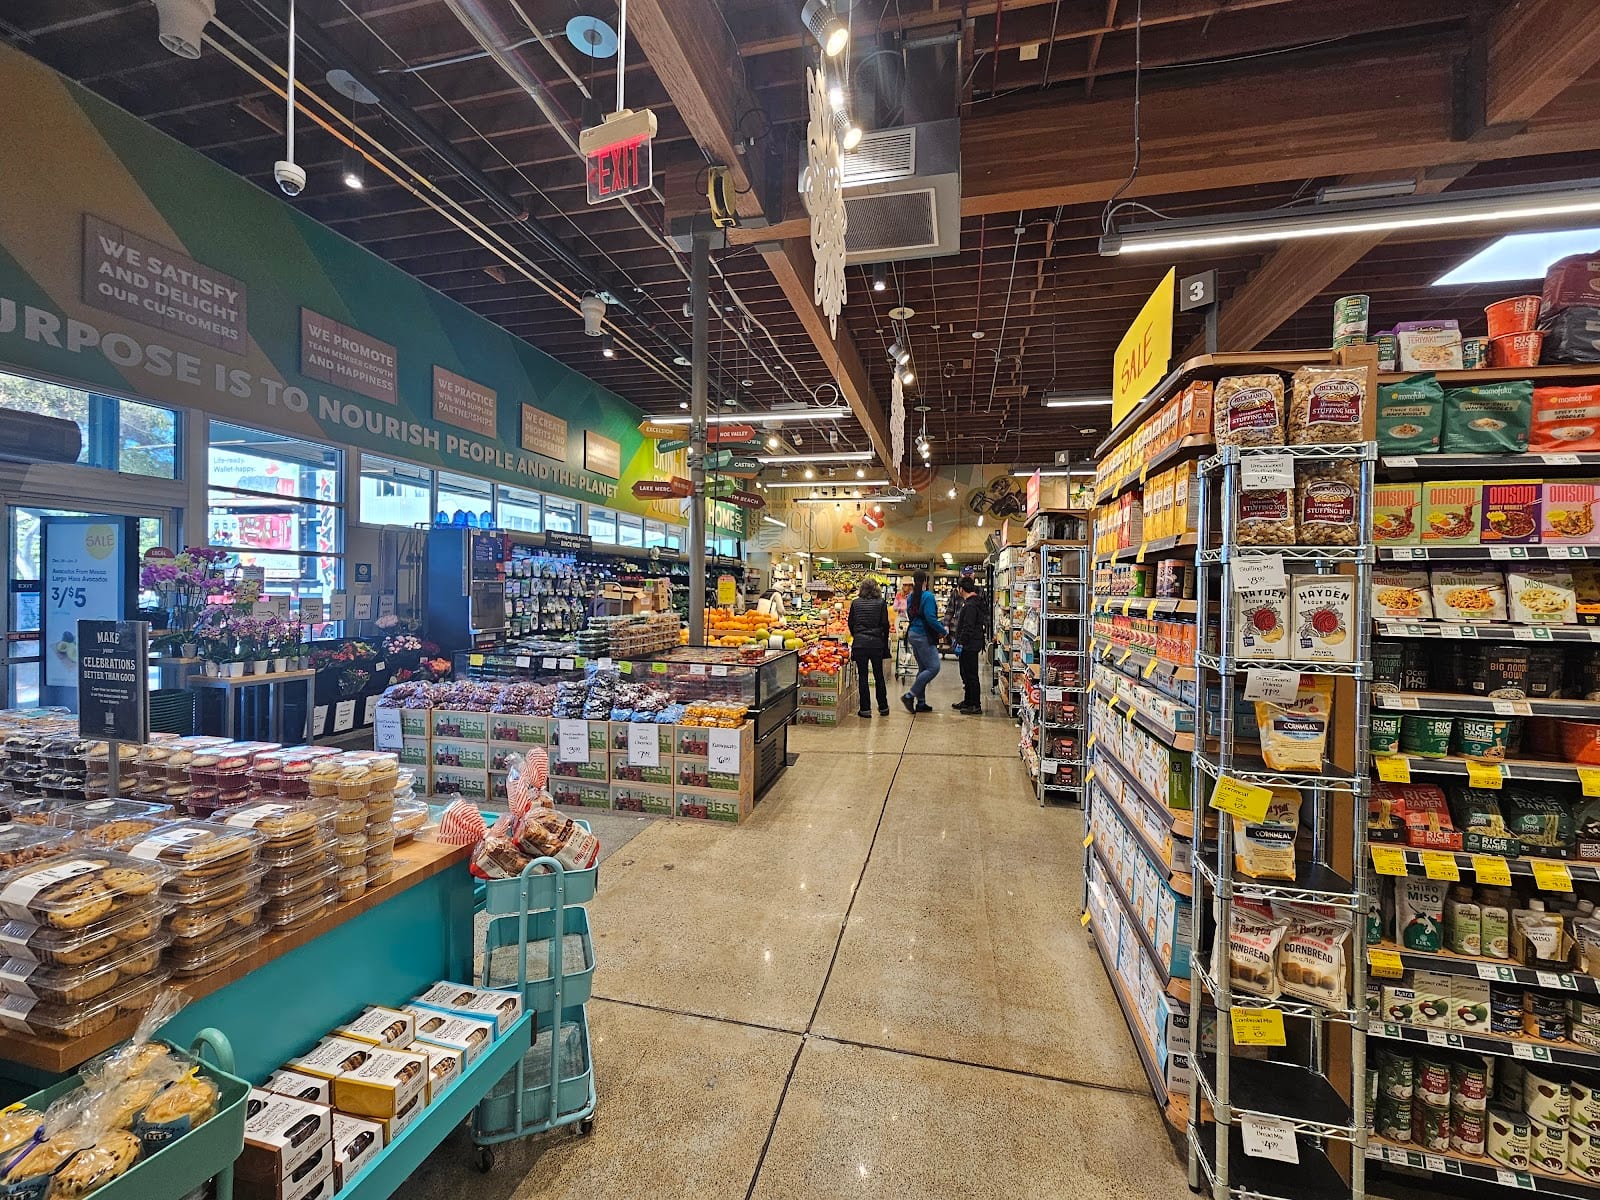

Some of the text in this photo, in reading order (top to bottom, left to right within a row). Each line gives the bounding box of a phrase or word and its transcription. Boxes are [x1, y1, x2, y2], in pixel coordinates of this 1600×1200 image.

[598, 141, 641, 196] EXIT
[98, 236, 239, 305] WE SATISFY
[98, 262, 238, 322] AND DELIGHT
[1189, 281, 1205, 302] 3
[98, 283, 239, 340] OUR CUSTOMERS
[308, 323, 394, 367] WE PROMOTE
[1408, 336, 1437, 345] TERIYAKI
[308, 340, 394, 379] TEAM MEMBER GROWTH
[1120, 320, 1154, 396] SALE
[308, 353, 394, 391] AND HAPPINESS
[438, 377, 495, 408] WE PRACTICE
[1398, 391, 1426, 401] momofuku
[1478, 385, 1512, 396] momofuku
[1558, 392, 1593, 403] momofuku
[467, 399, 494, 417] SUPPLIER
[1312, 407, 1344, 415] STUFFING
[438, 402, 494, 427] PARTNERSHIPS
[1232, 413, 1263, 424] STUFFING
[525, 411, 565, 434] WE CREATE
[215, 363, 619, 499] IS TO NOURISH PEOPLE AND THE PLANET
[551, 434, 565, 445] AND
[1059, 453, 1066, 463] 4
[740, 496, 759, 505] BEACH
[1307, 507, 1338, 515] STUFFING
[708, 503, 735, 531] HOME
[86, 534, 116, 548] SALE
[1371, 577, 1403, 585] TERIYAKI
[1441, 577, 1476, 586] PAD THAI
[1524, 580, 1544, 588] MISO
[51, 586, 87, 608] 3/$5
[1298, 589, 1350, 601] HAYDEN
[97, 631, 120, 644] MAKE
[83, 657, 136, 670] CELEBRATIONS
[1490, 662, 1505, 671] BIG
[83, 670, 136, 682] BETTER THAN GOOD
[1502, 670, 1523, 680] BOWL
[459, 720, 485, 732] BEST
[1283, 722, 1319, 731] CORNMEAL
[1372, 720, 1397, 728] RICE
[1463, 722, 1494, 733] RICE
[516, 724, 545, 736] BEST
[1463, 730, 1493, 738] RAMEN
[458, 750, 484, 761] BEST
[459, 779, 485, 791] BEST
[580, 789, 608, 800] BEST
[1403, 790, 1441, 801] RICE
[641, 795, 670, 806] BEST
[1405, 800, 1443, 809] RAMEN
[706, 801, 737, 815] BEST
[1255, 829, 1292, 840] CORNMEAL
[1481, 837, 1508, 846] RICE
[1481, 844, 1508, 852] RAMEN
[1406, 883, 1439, 893] SHIRO
[1407, 891, 1439, 904] MISO
[1240, 924, 1273, 937] Red Mill
[1300, 924, 1335, 937] Red Mill
[1284, 942, 1334, 964] CORNBREAD
[1395, 989, 1414, 998] kara
[1174, 1017, 1188, 1025] 365
[1174, 1056, 1188, 1065] 365
[1426, 1075, 1447, 1084] COCONUT
[1464, 1080, 1485, 1088] COCONUT
[1546, 1150, 1561, 1158] Milk
